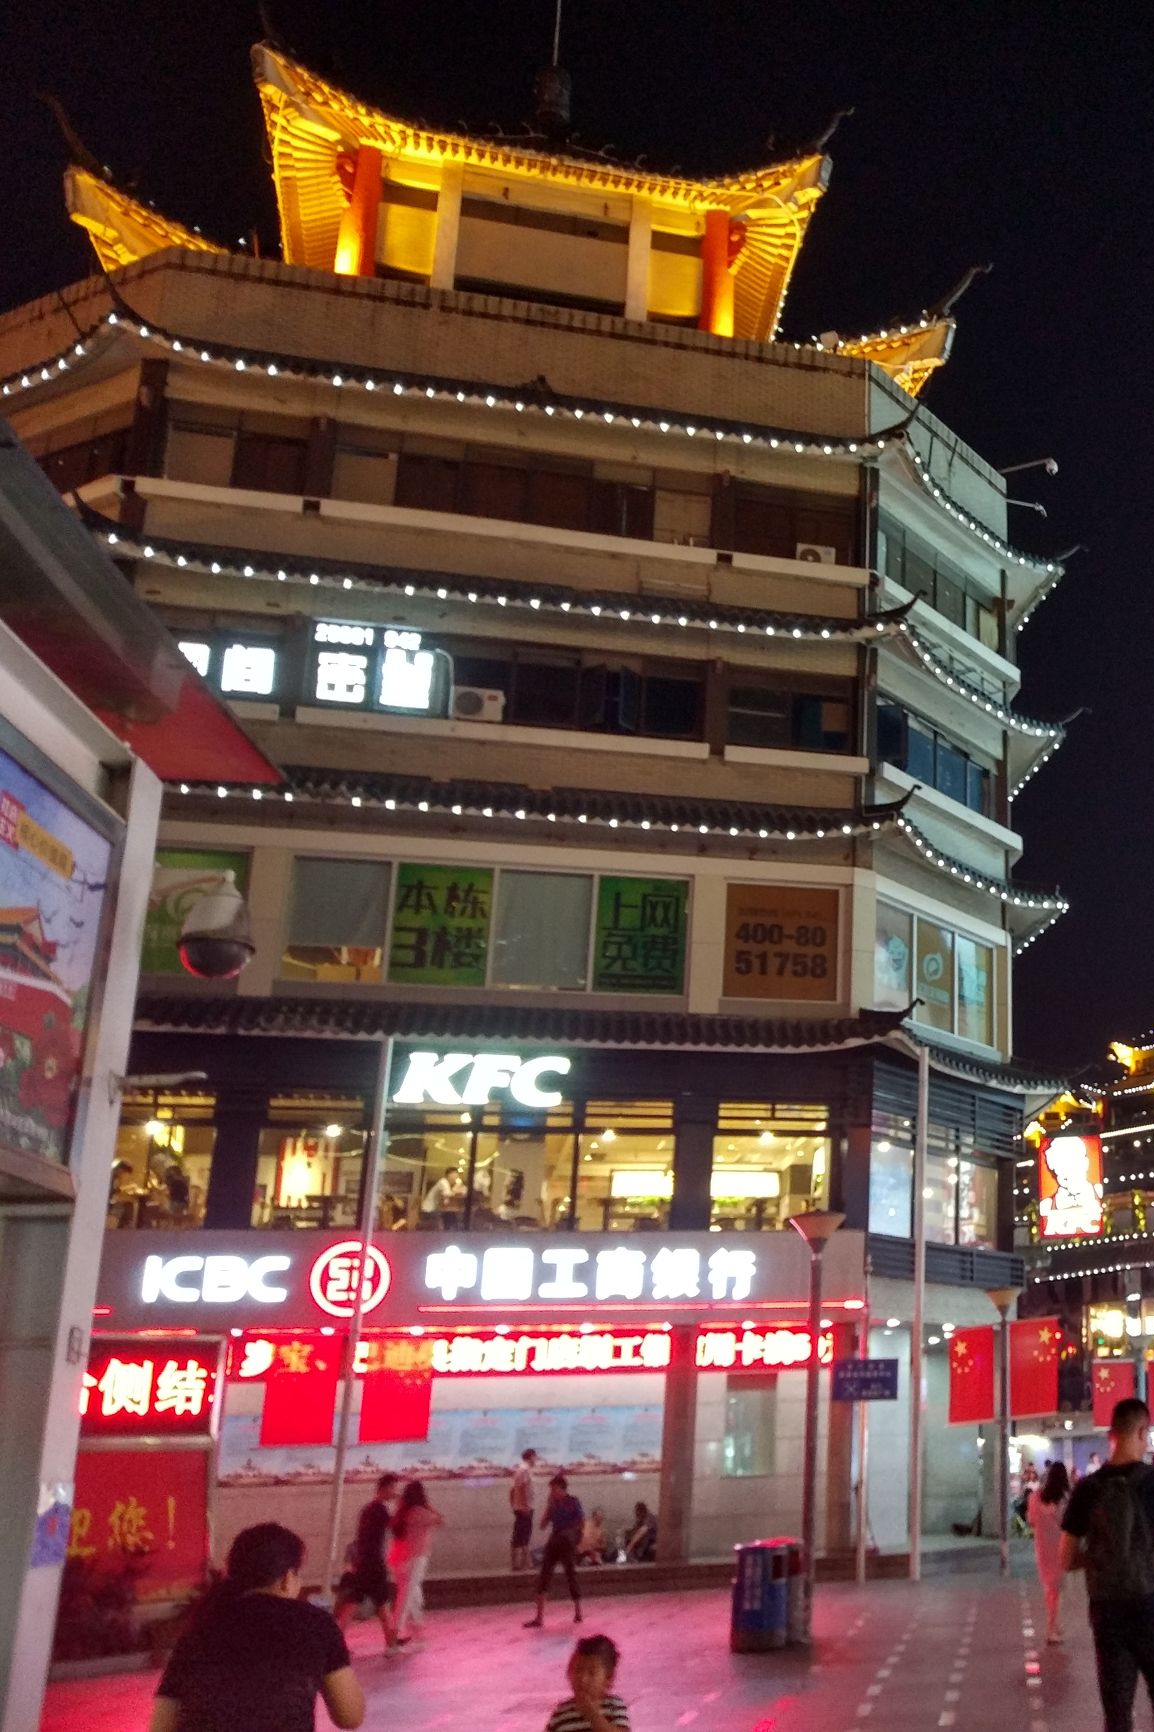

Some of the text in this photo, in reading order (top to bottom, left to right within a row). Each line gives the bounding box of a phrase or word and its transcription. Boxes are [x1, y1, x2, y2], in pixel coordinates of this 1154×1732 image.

[600, 892, 680, 934] 上网
[602, 931, 679, 974] 免费
[736, 922, 826, 948] 400-80
[735, 951, 828, 979] 51758
[392, 1051, 571, 1108] KFC
[140, 1254, 291, 1304] ICBC
[424, 1245, 756, 1301] 中国工商银行
